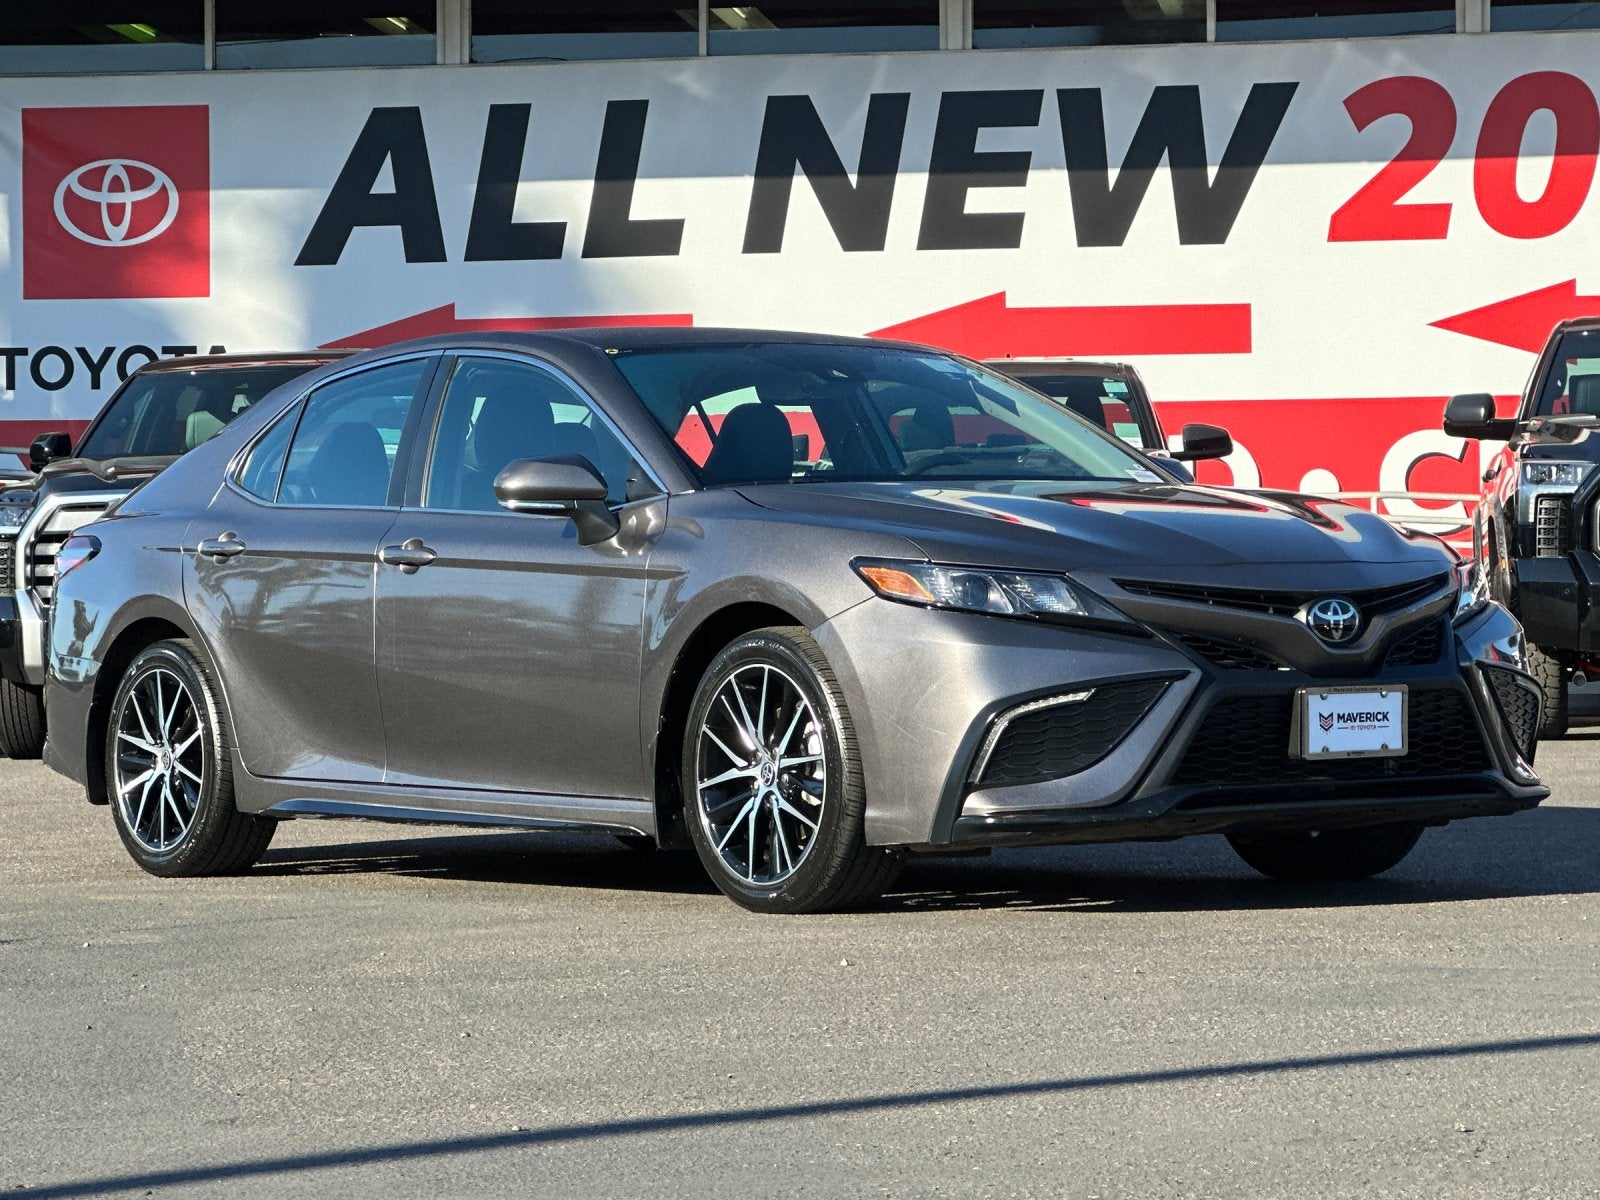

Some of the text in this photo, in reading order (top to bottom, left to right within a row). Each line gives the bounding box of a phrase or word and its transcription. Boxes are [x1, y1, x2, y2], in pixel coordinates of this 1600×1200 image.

[294, 70, 1600, 266] ALL NEW 20
[1337, 711, 1390, 724] MAVERICK
